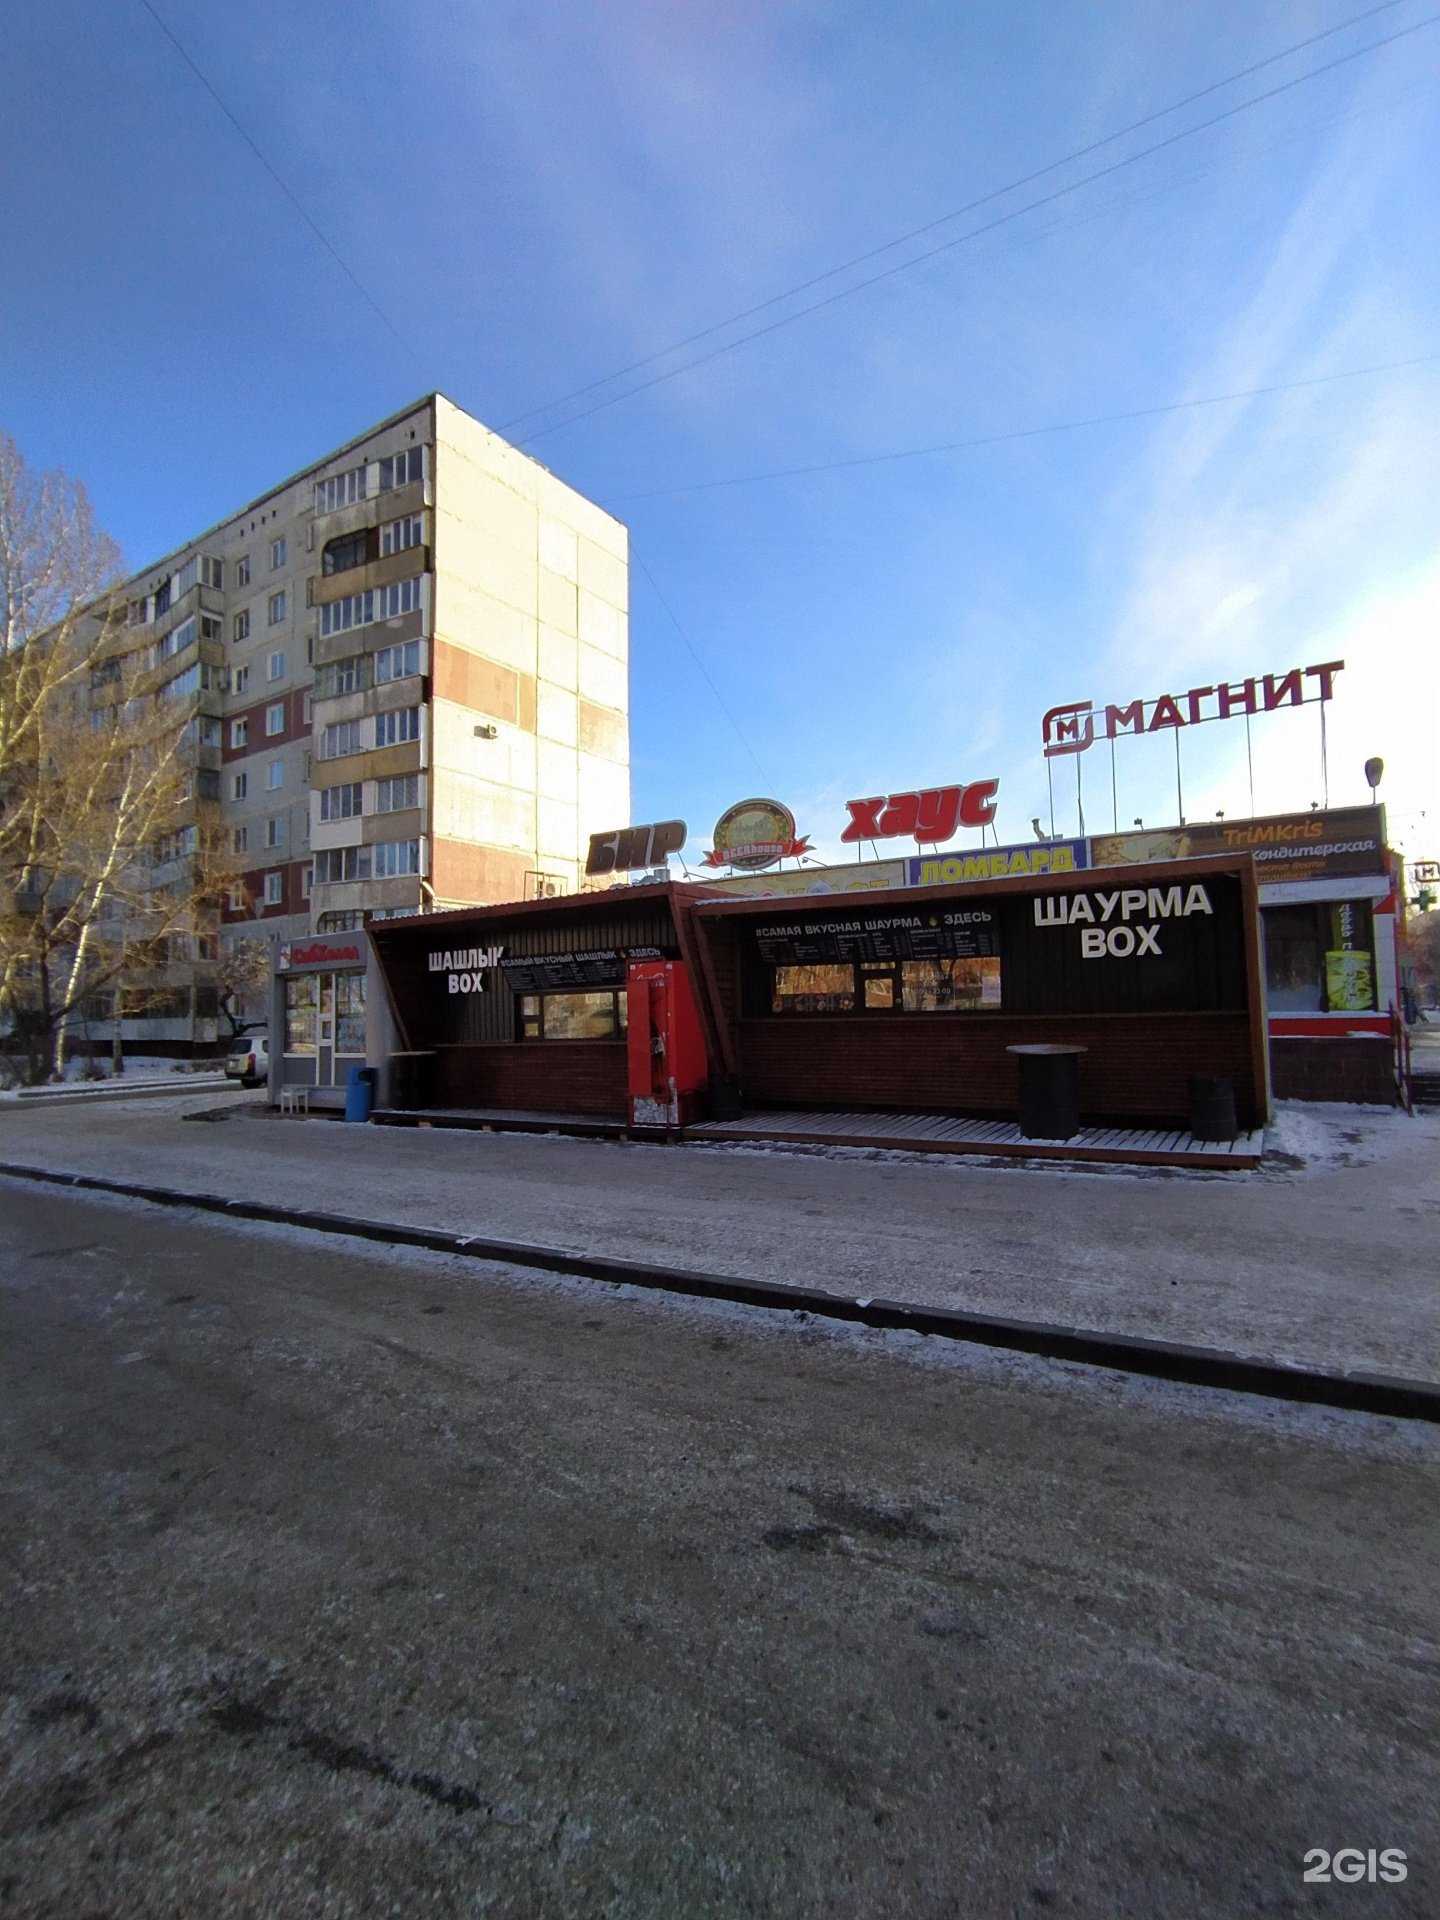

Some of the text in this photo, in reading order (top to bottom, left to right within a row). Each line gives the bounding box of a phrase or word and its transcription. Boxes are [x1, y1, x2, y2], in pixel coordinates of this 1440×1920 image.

[1105, 660, 1344, 739] МАГНИТ
[919, 844, 1078, 885] ЛОМБАРД
[756, 911, 992, 937] #САМАЯ ВКУСНАЯ ШАУРМА ЗДЕСЬ
[1034, 884, 1214, 927] ШАУРМА
[575, 950, 617, 961] ШАШЛЫК
[629, 947, 661, 957] ЗДЕСЬ
